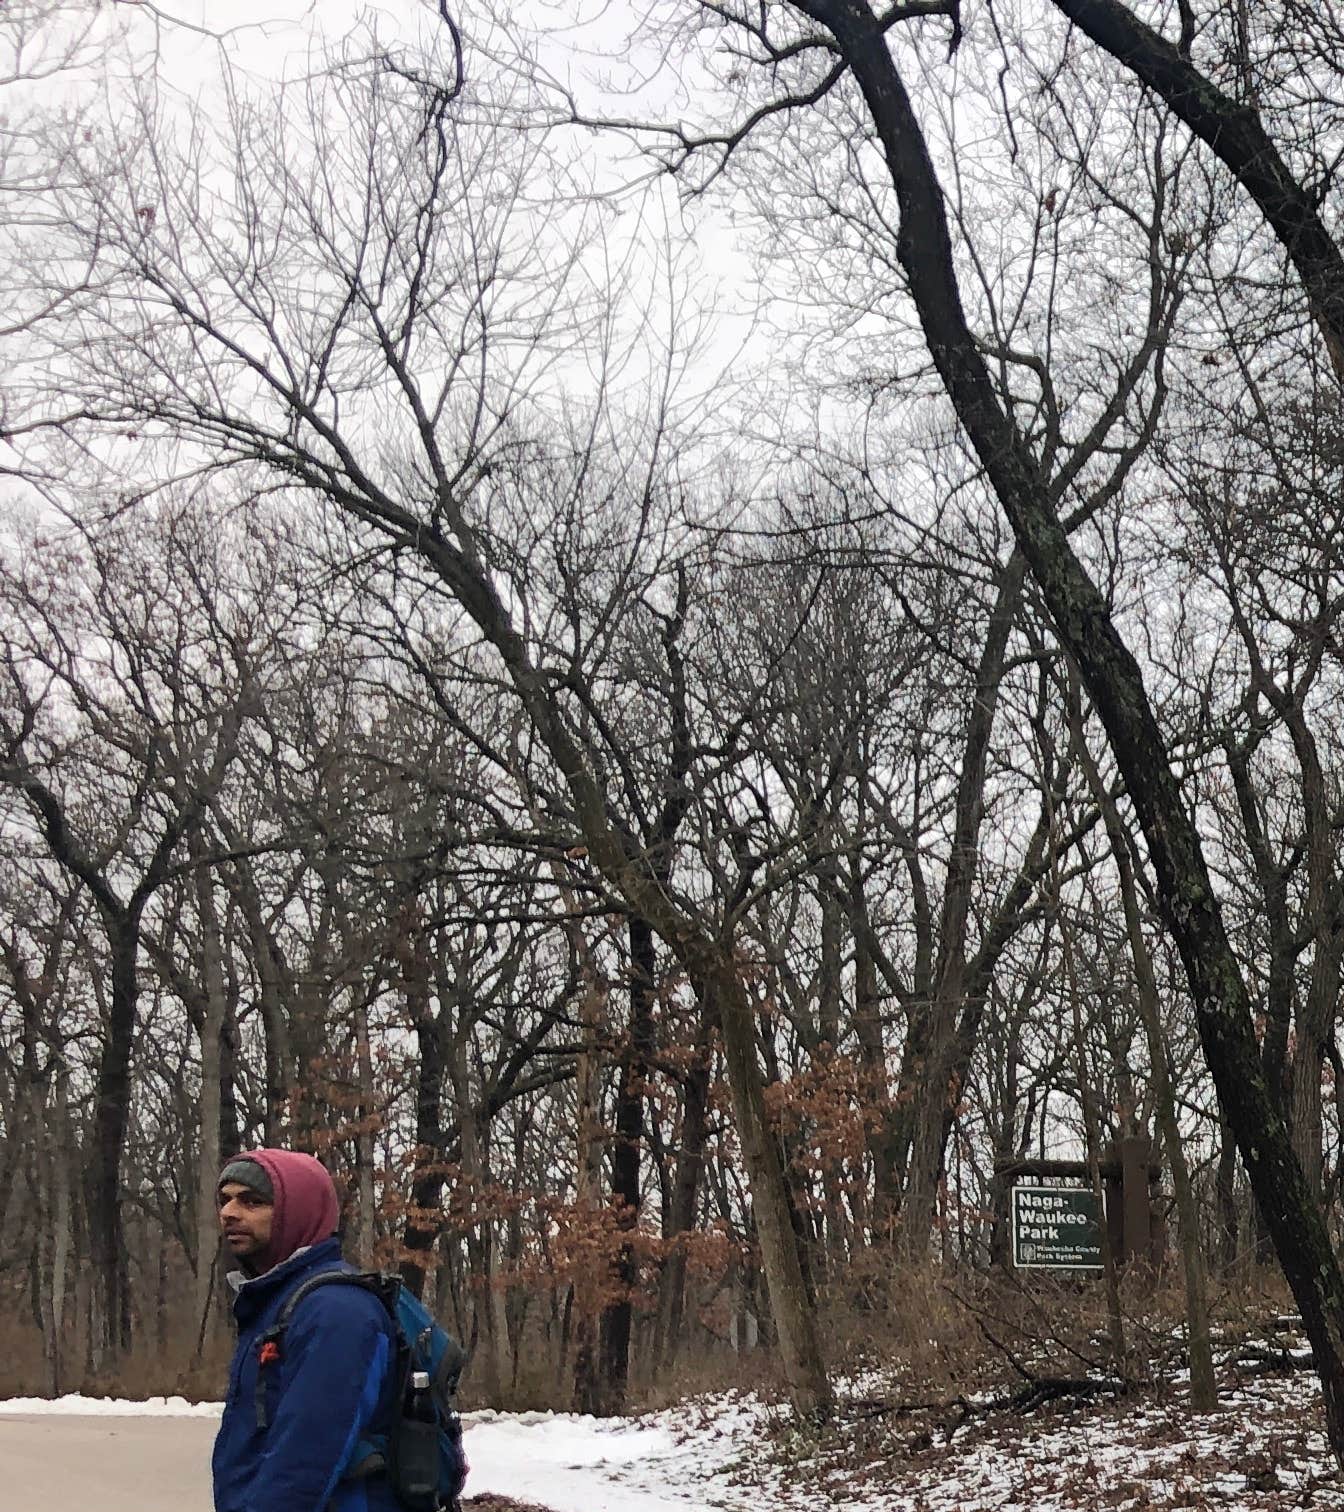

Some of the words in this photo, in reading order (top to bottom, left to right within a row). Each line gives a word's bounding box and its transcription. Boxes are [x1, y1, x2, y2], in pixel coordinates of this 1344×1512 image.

[1019, 1193, 1069, 1210] Naga-
[1019, 1210, 1087, 1225] Waukee
[1019, 1225, 1059, 1239] Park
